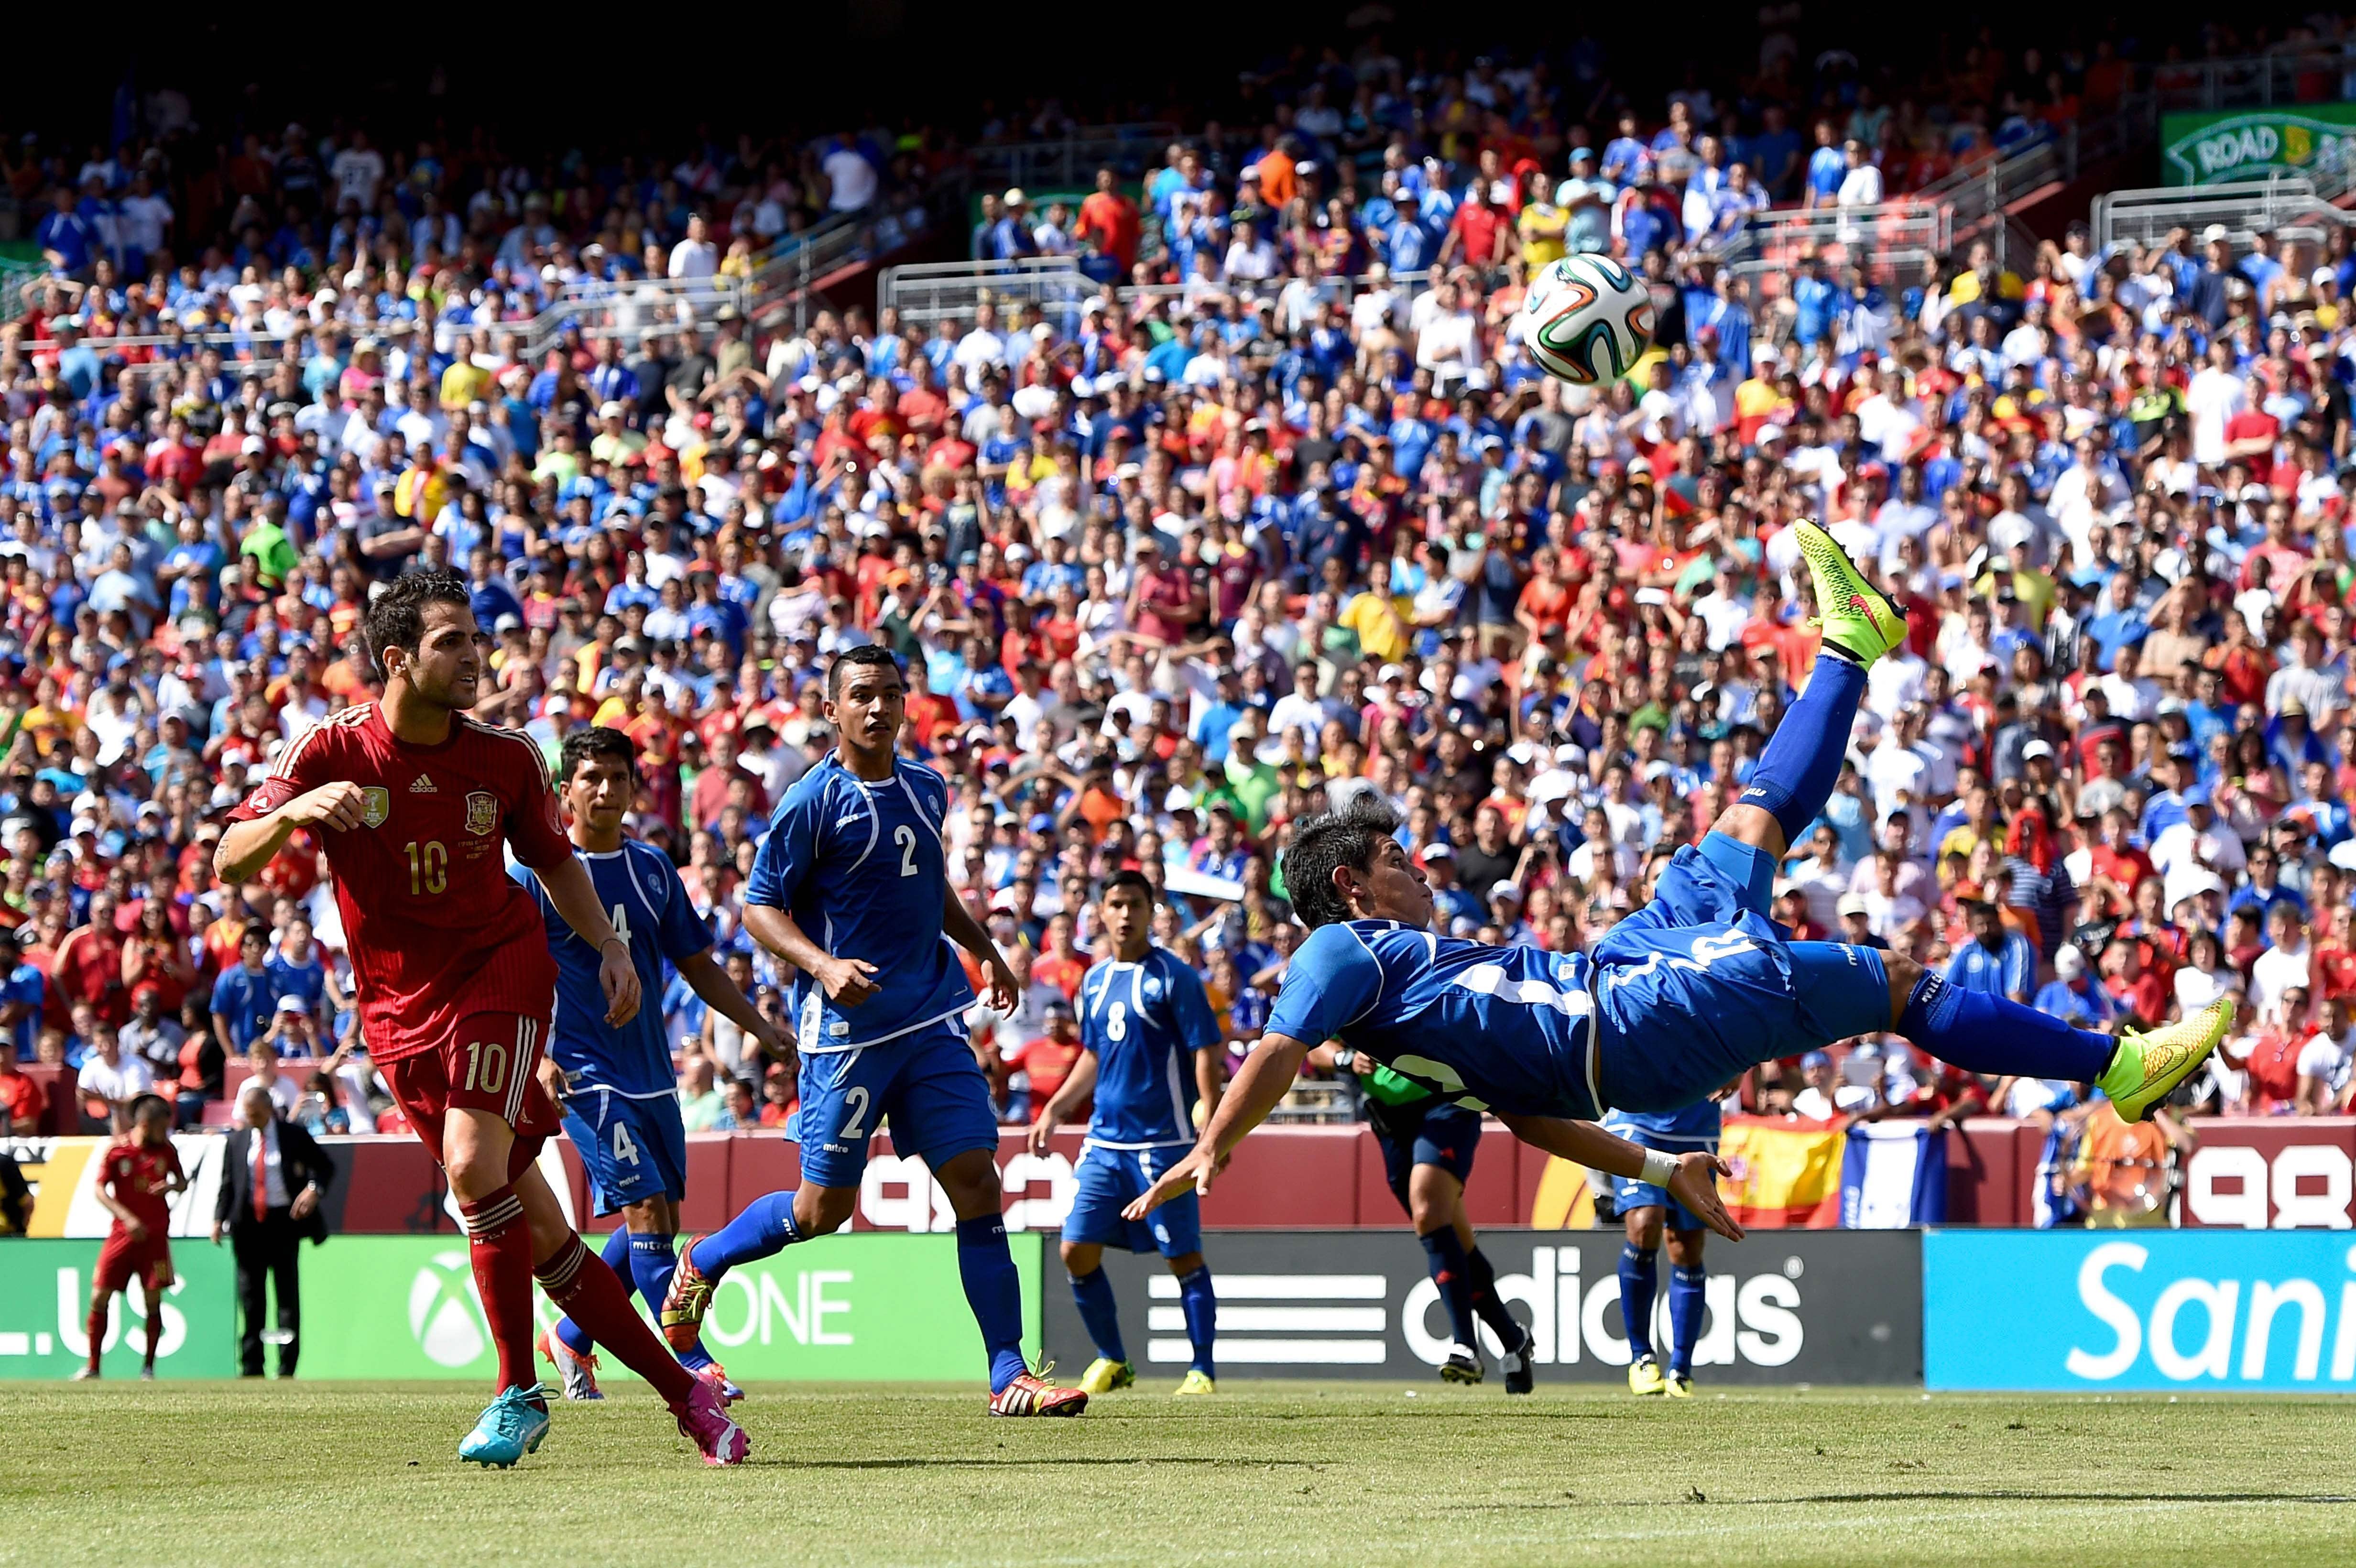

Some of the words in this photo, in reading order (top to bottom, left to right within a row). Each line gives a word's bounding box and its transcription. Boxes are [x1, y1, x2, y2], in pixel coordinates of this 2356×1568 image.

[2196, 125, 2280, 174] ROAD
[404, 840, 447, 895] 10
[894, 825, 918, 877] 2
[612, 904, 632, 956] 4
[1107, 1001, 1126, 1041] 8
[465, 1042, 507, 1093] 10
[839, 1086, 869, 1139] 2
[613, 1121, 640, 1166] 4
[823, 1143, 849, 1153] mitre
[619, 1174, 641, 1187] mitre
[2169, 1144, 2353, 1230] 98
[633, 1241, 673, 1251] mitre
[0, 1267, 187, 1358] .US
[707, 1270, 854, 1347] ONE
[2065, 1241, 2356, 1381] Sani
